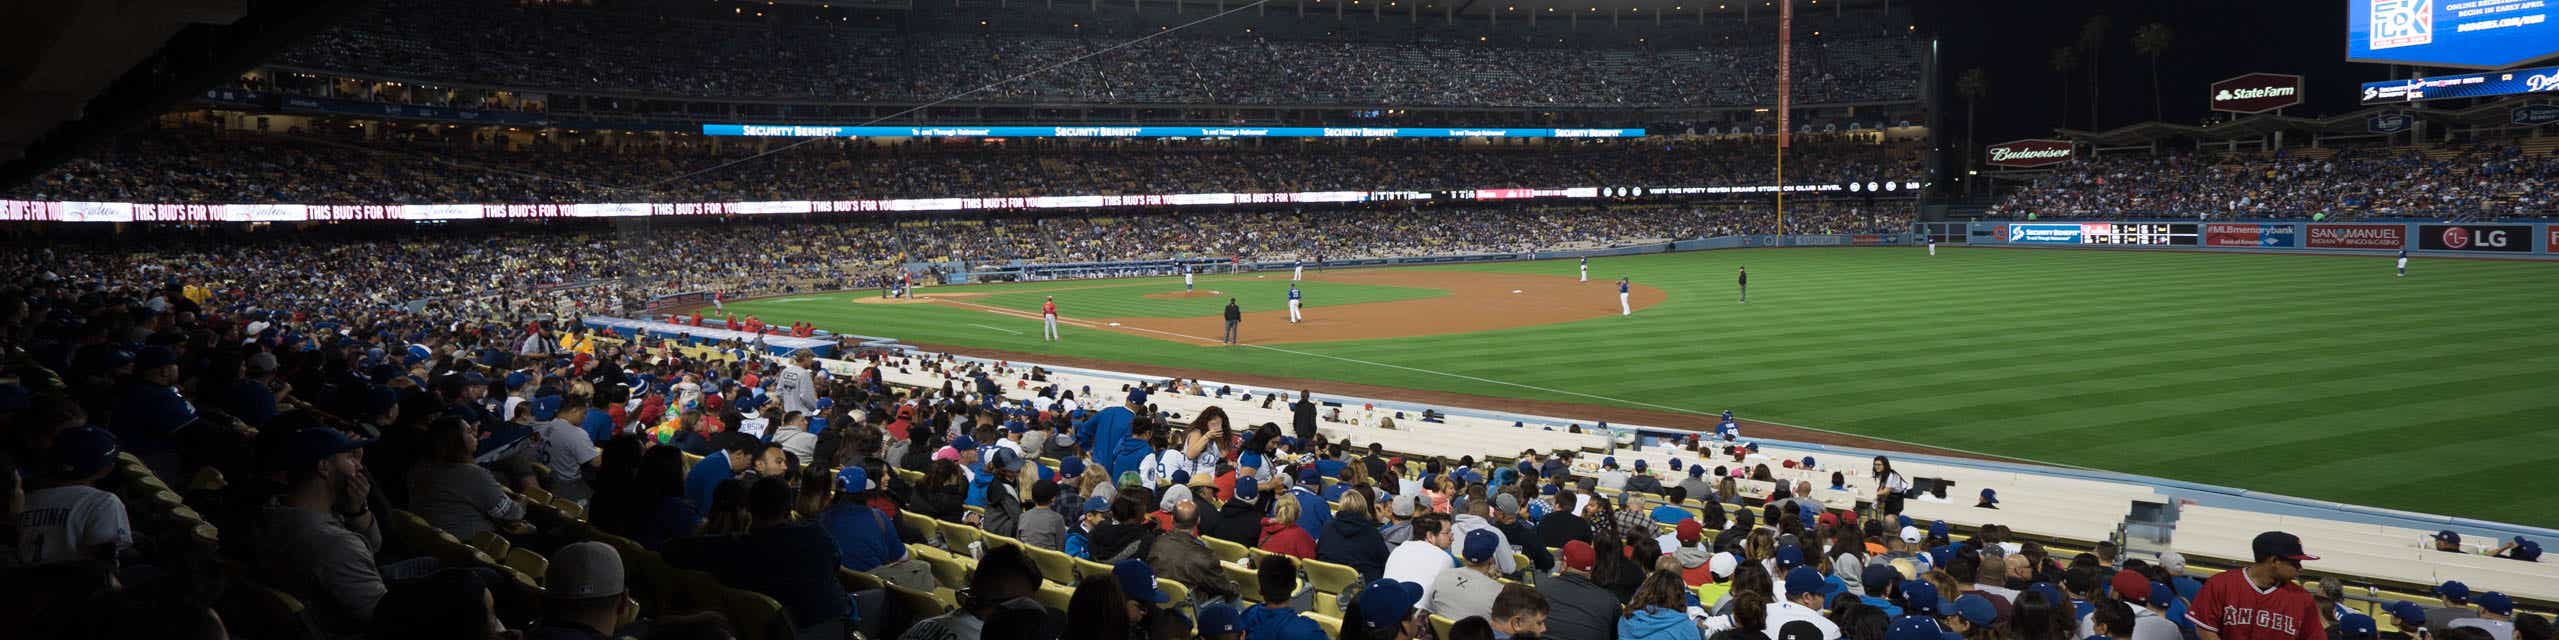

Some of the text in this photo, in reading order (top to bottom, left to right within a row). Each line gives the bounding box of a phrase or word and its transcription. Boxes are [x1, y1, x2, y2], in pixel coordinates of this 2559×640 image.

[1990, 147, 2071, 162] Budweiser
[653, 203, 674, 215] THIS
[675, 203, 702, 215] BUD'S
[704, 202, 722, 215] FOR
[812, 201, 832, 212] THIS
[833, 201, 859, 212] BUD'S
[860, 200, 877, 211] FOR
[963, 199, 981, 208] THIS
[982, 198, 1007, 208] BUD'S
[1008, 198, 1024, 208] FOR
[134, 204, 156, 221] THIS
[157, 204, 185, 221] BUD'S
[187, 205, 206, 221] FOR
[308, 205, 331, 220] THIS
[333, 205, 362, 220] BUD'S
[364, 205, 384, 219] FOR
[484, 204, 506, 217] THIS
[508, 204, 537, 217] BUD'S
[539, 204, 557, 217] FOR
[2311, 228, 2400, 239] SAN MANUEL
[2474, 230, 2507, 247] LG
[2223, 604, 2296, 636] ANGEL
